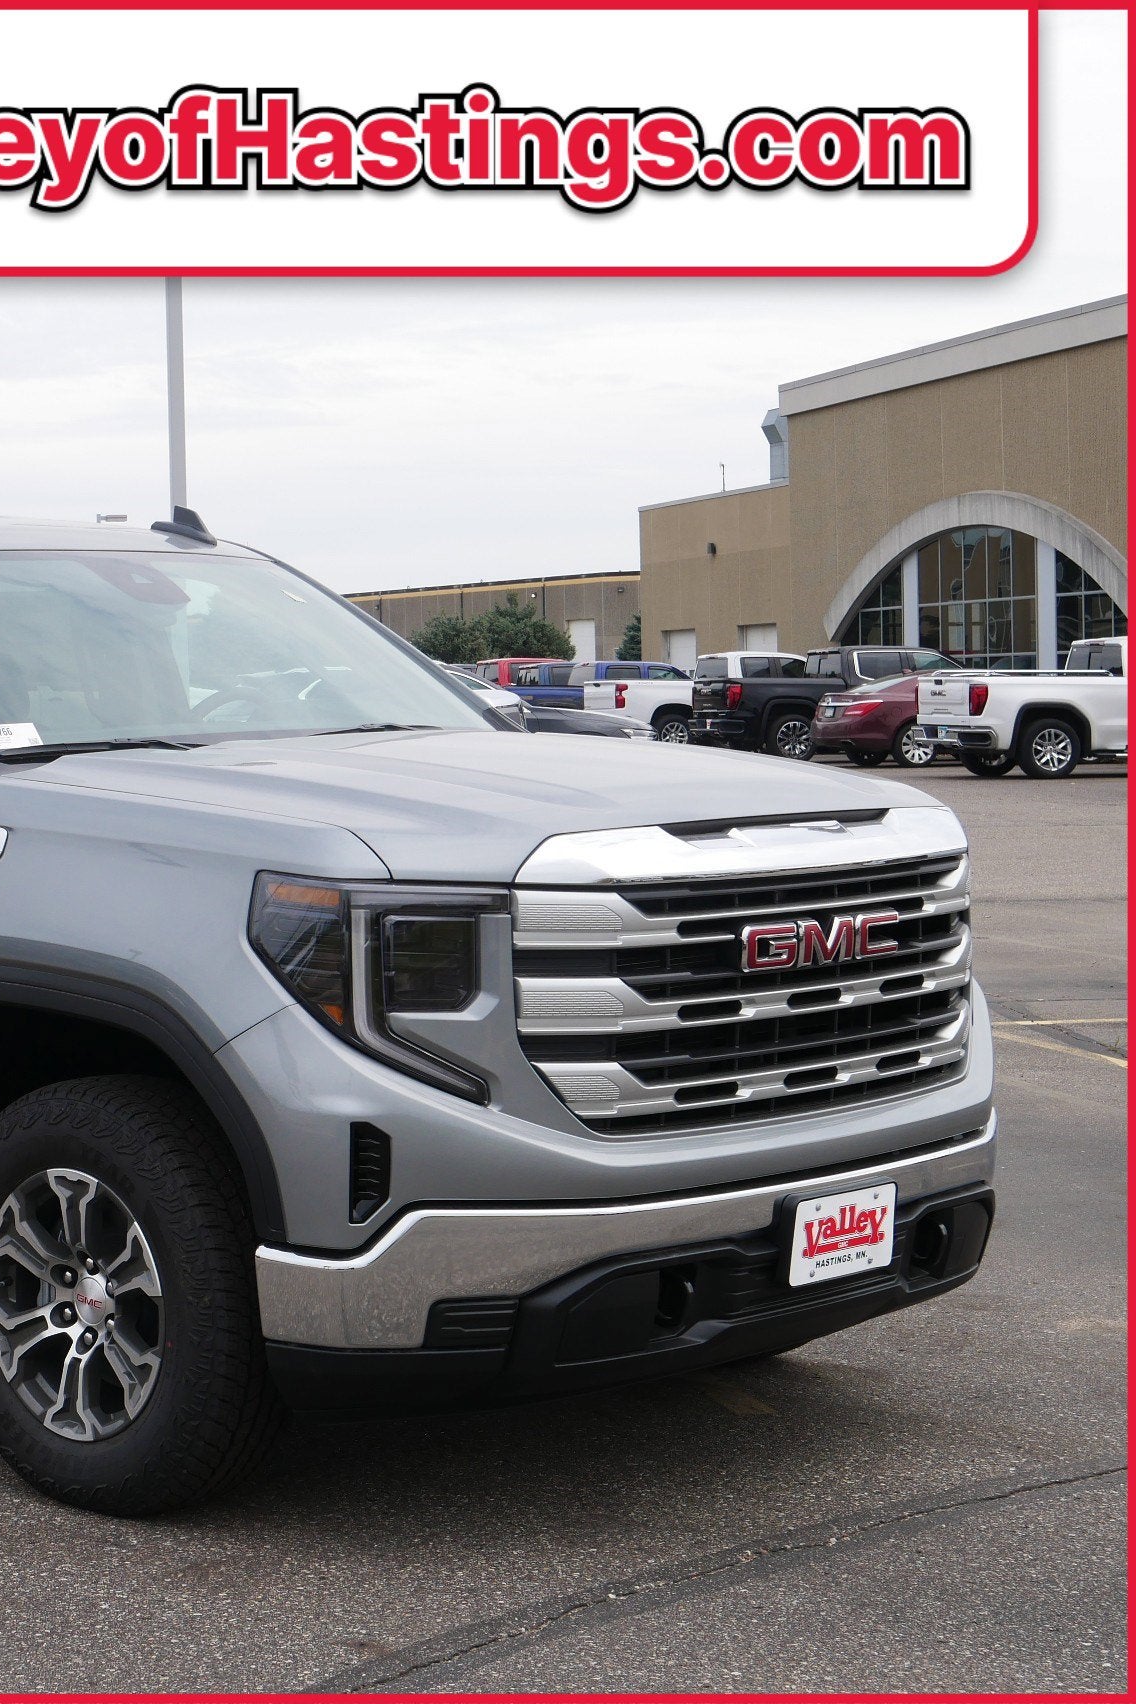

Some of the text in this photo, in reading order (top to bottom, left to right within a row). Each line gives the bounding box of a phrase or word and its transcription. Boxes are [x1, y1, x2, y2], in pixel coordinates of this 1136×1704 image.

[741, 911, 899, 973] GMC
[815, 1254, 853, 1268] HASTINGS,
[76, 1293, 104, 1309] GMC
